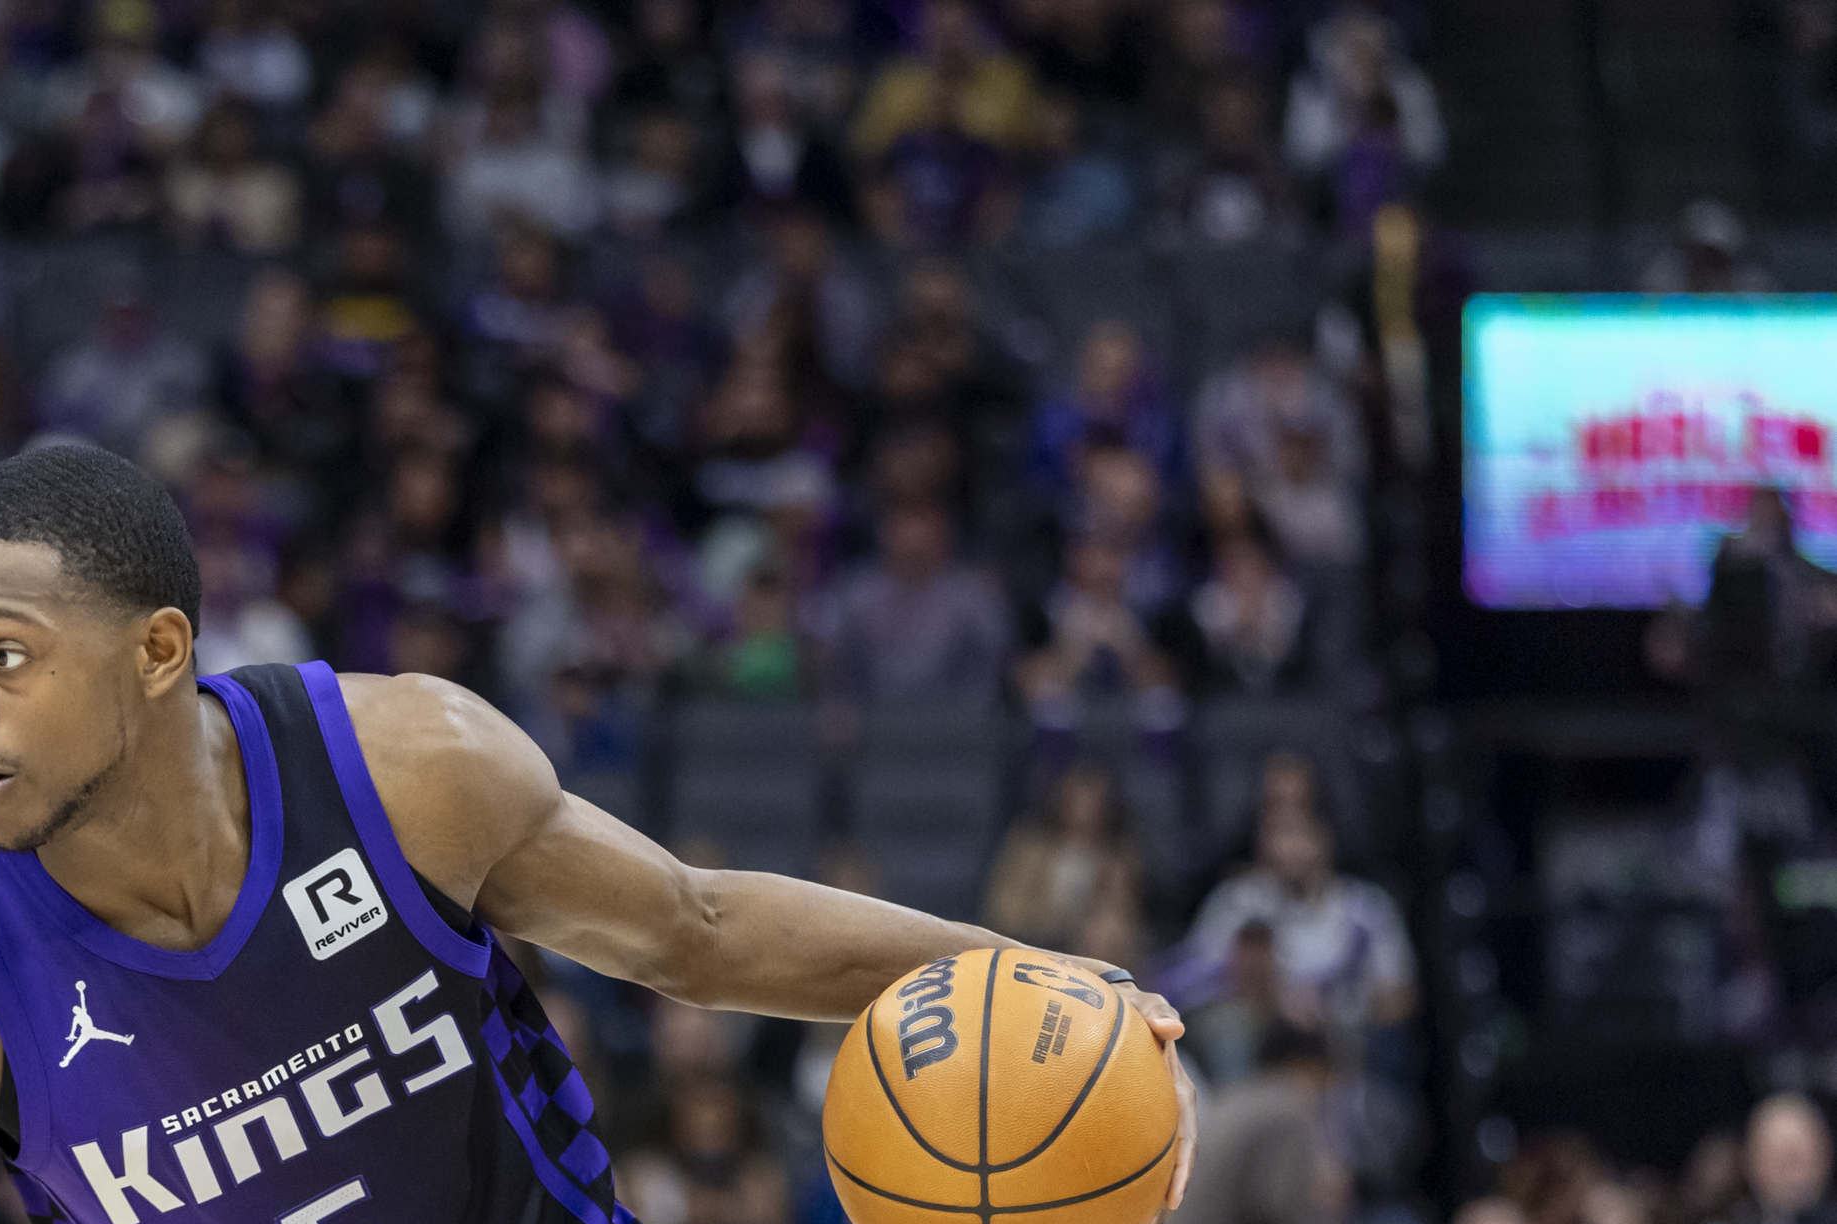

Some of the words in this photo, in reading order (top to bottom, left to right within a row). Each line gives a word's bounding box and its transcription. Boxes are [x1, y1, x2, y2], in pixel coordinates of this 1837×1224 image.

[304, 867, 363, 924] R
[314, 906, 382, 951] REVIVER
[1031, 1031, 1053, 1065] OFFICIAL
[161, 1023, 364, 1134] SACRAMENTO
